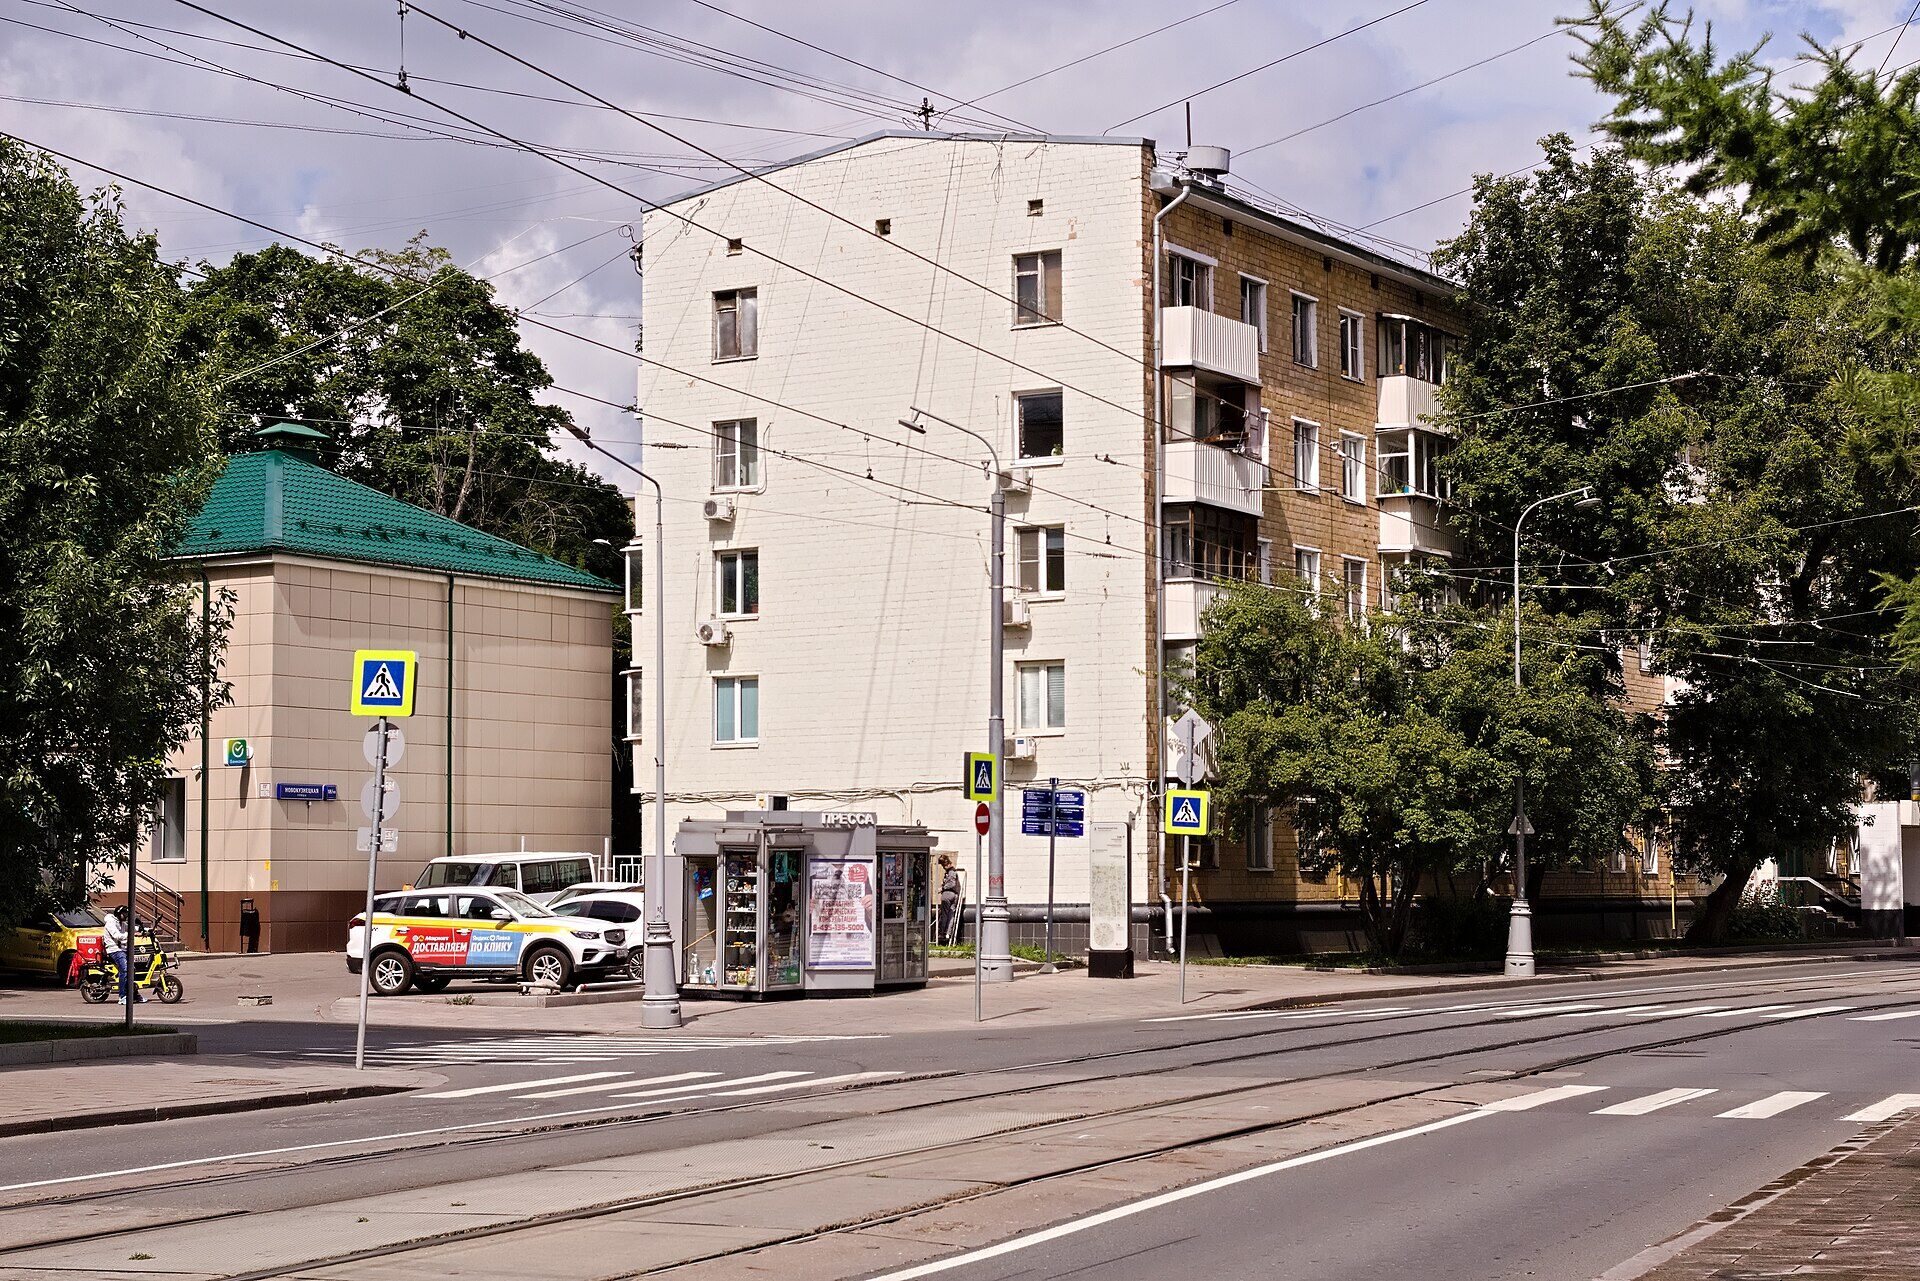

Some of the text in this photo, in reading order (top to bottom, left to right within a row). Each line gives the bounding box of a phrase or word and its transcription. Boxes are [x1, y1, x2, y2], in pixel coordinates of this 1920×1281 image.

[821, 812, 875, 825] ПРЕССА
[411, 941, 513, 955] ДОСТАВЛЯЕМ ПО КЛИКУ
